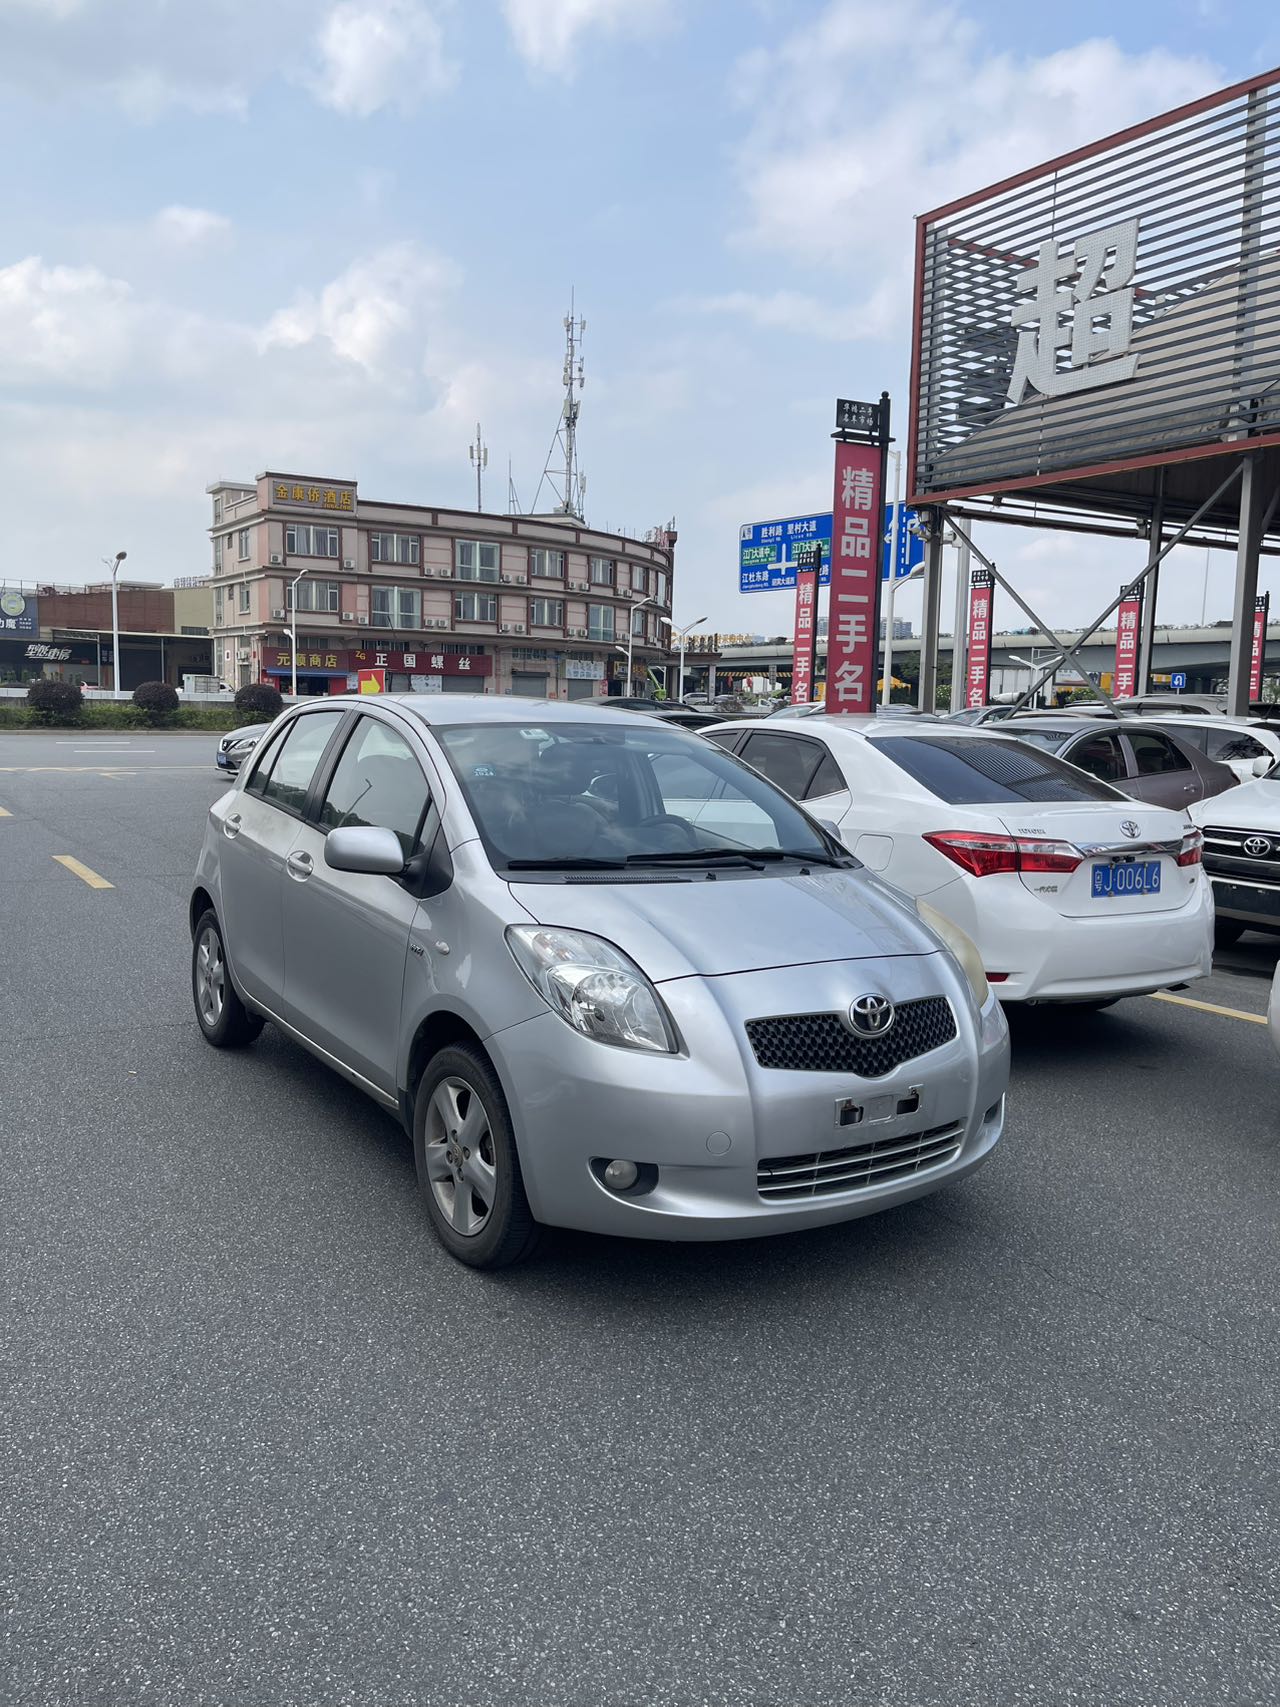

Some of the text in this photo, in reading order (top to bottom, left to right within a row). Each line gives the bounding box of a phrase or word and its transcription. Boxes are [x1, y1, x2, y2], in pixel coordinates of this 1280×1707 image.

[1006, 217, 1141, 406] 超
[275, 484, 353, 506] 金康侨酒店
[761, 525, 783, 538] 胜利路
[743, 548, 771, 560] 江门大道中
[742, 570, 769, 583] 江杜东路
[834, 466, 874, 714] 精品二手名
[795, 582, 813, 702] 精品二手名
[276, 652, 337, 667] 元顺商店
[374, 652, 471, 670] 正国螺丝
